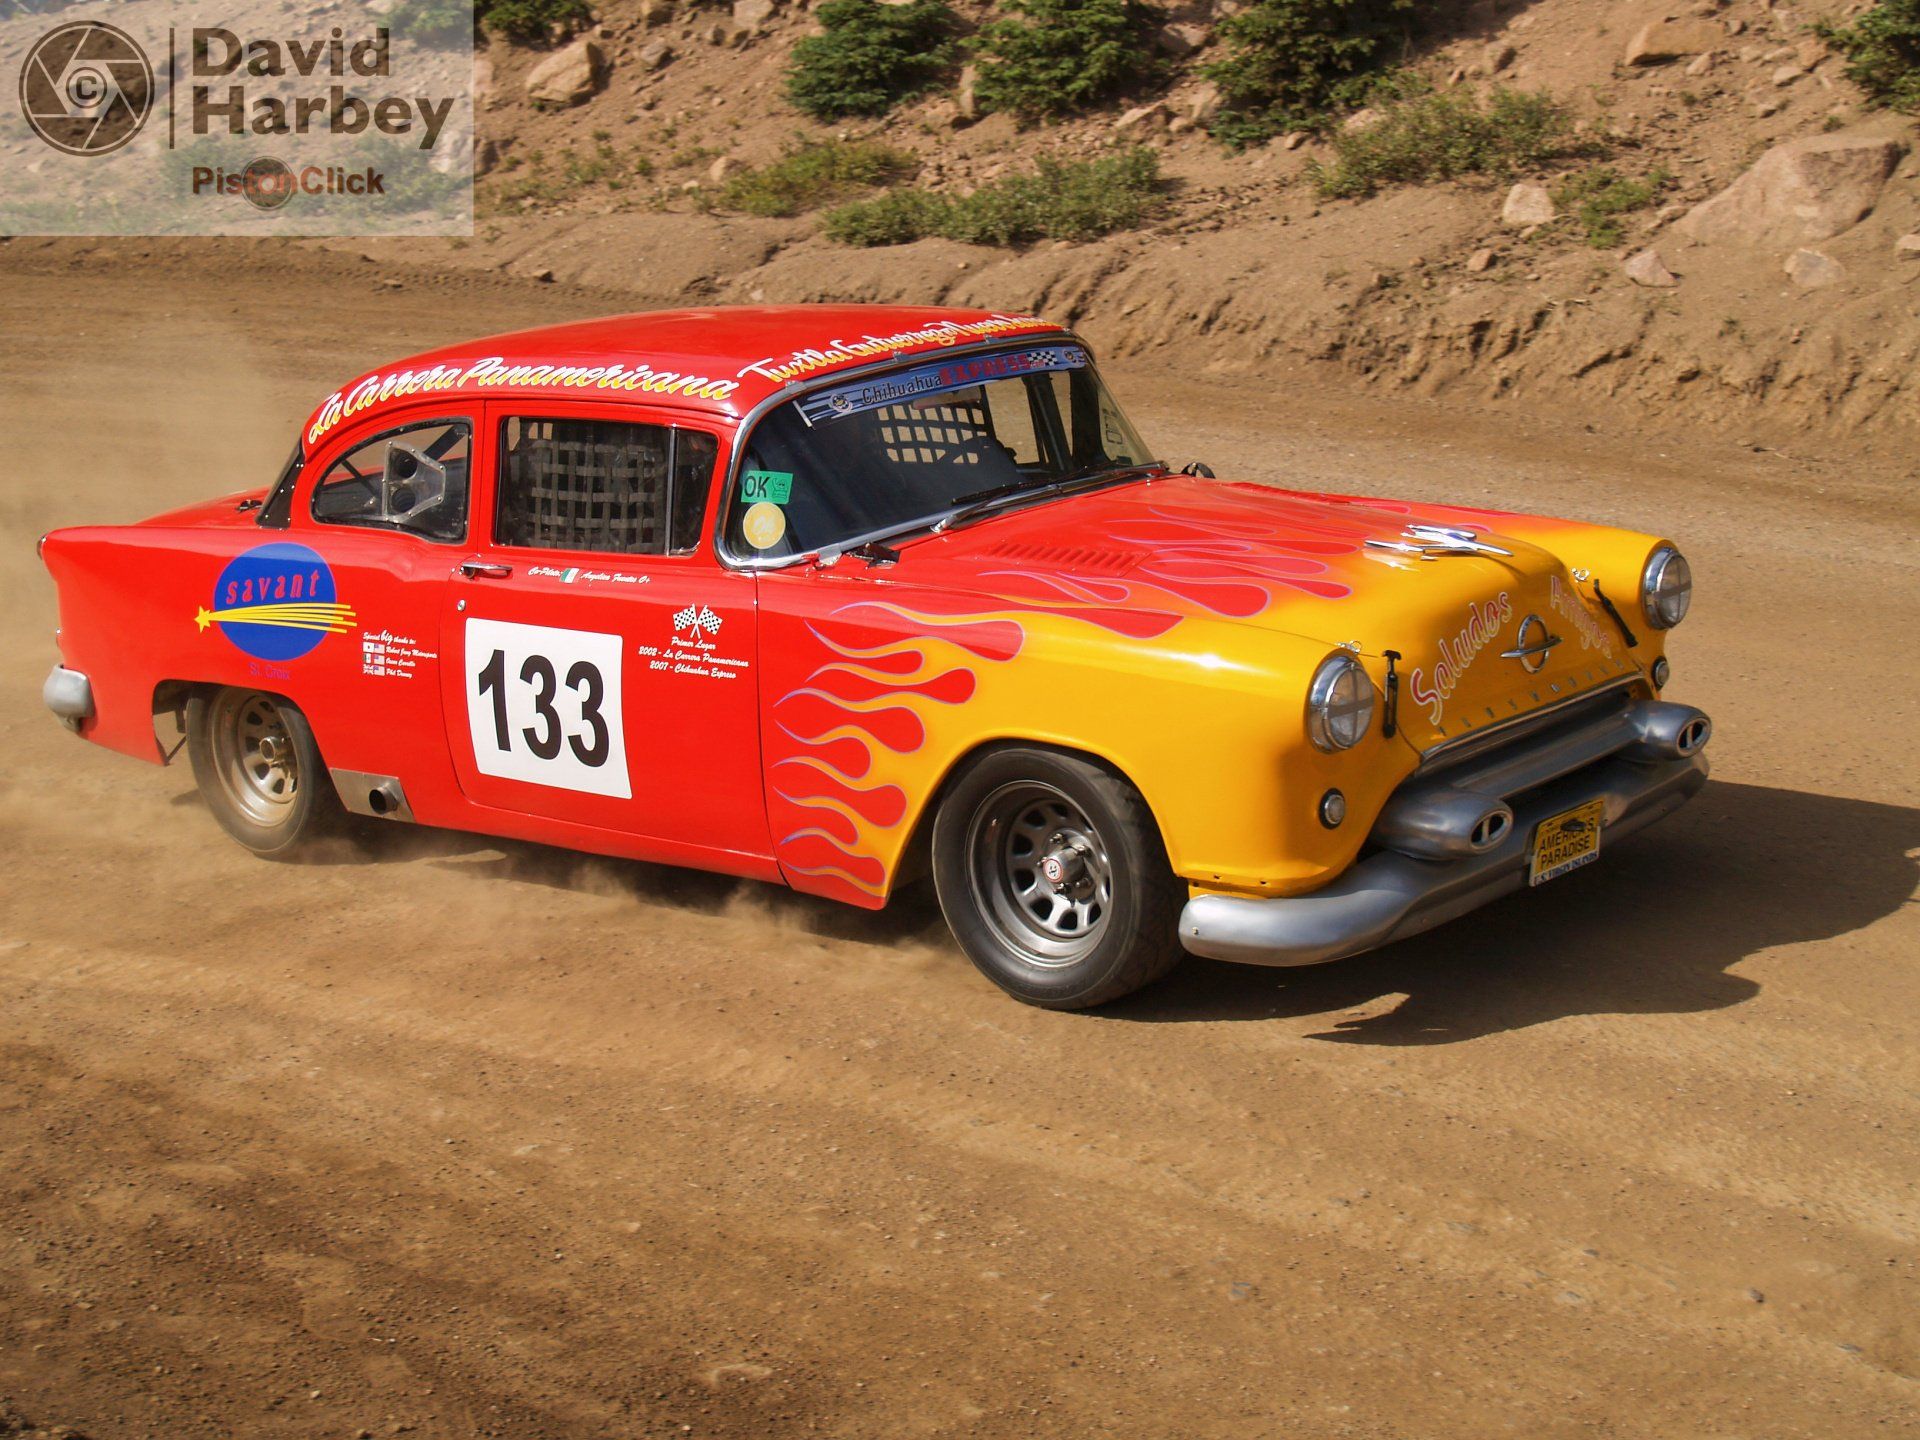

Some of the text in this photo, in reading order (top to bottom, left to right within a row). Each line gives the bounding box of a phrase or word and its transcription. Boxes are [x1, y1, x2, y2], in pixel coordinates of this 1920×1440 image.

[736, 348, 854, 383] Tuxtla
[862, 375, 942, 405] Chihuahua
[939, 354, 1032, 386] EXPRESS
[308, 357, 740, 443] La Carrera Panamericana
[744, 475, 771, 499] OK
[226, 569, 320, 605] savant
[380, 629, 393, 645] big
[649, 660, 669, 671] 2007
[1410, 591, 1513, 726] Saludos
[478, 648, 610, 769] 133
[1541, 834, 1590, 865] PARADISE
